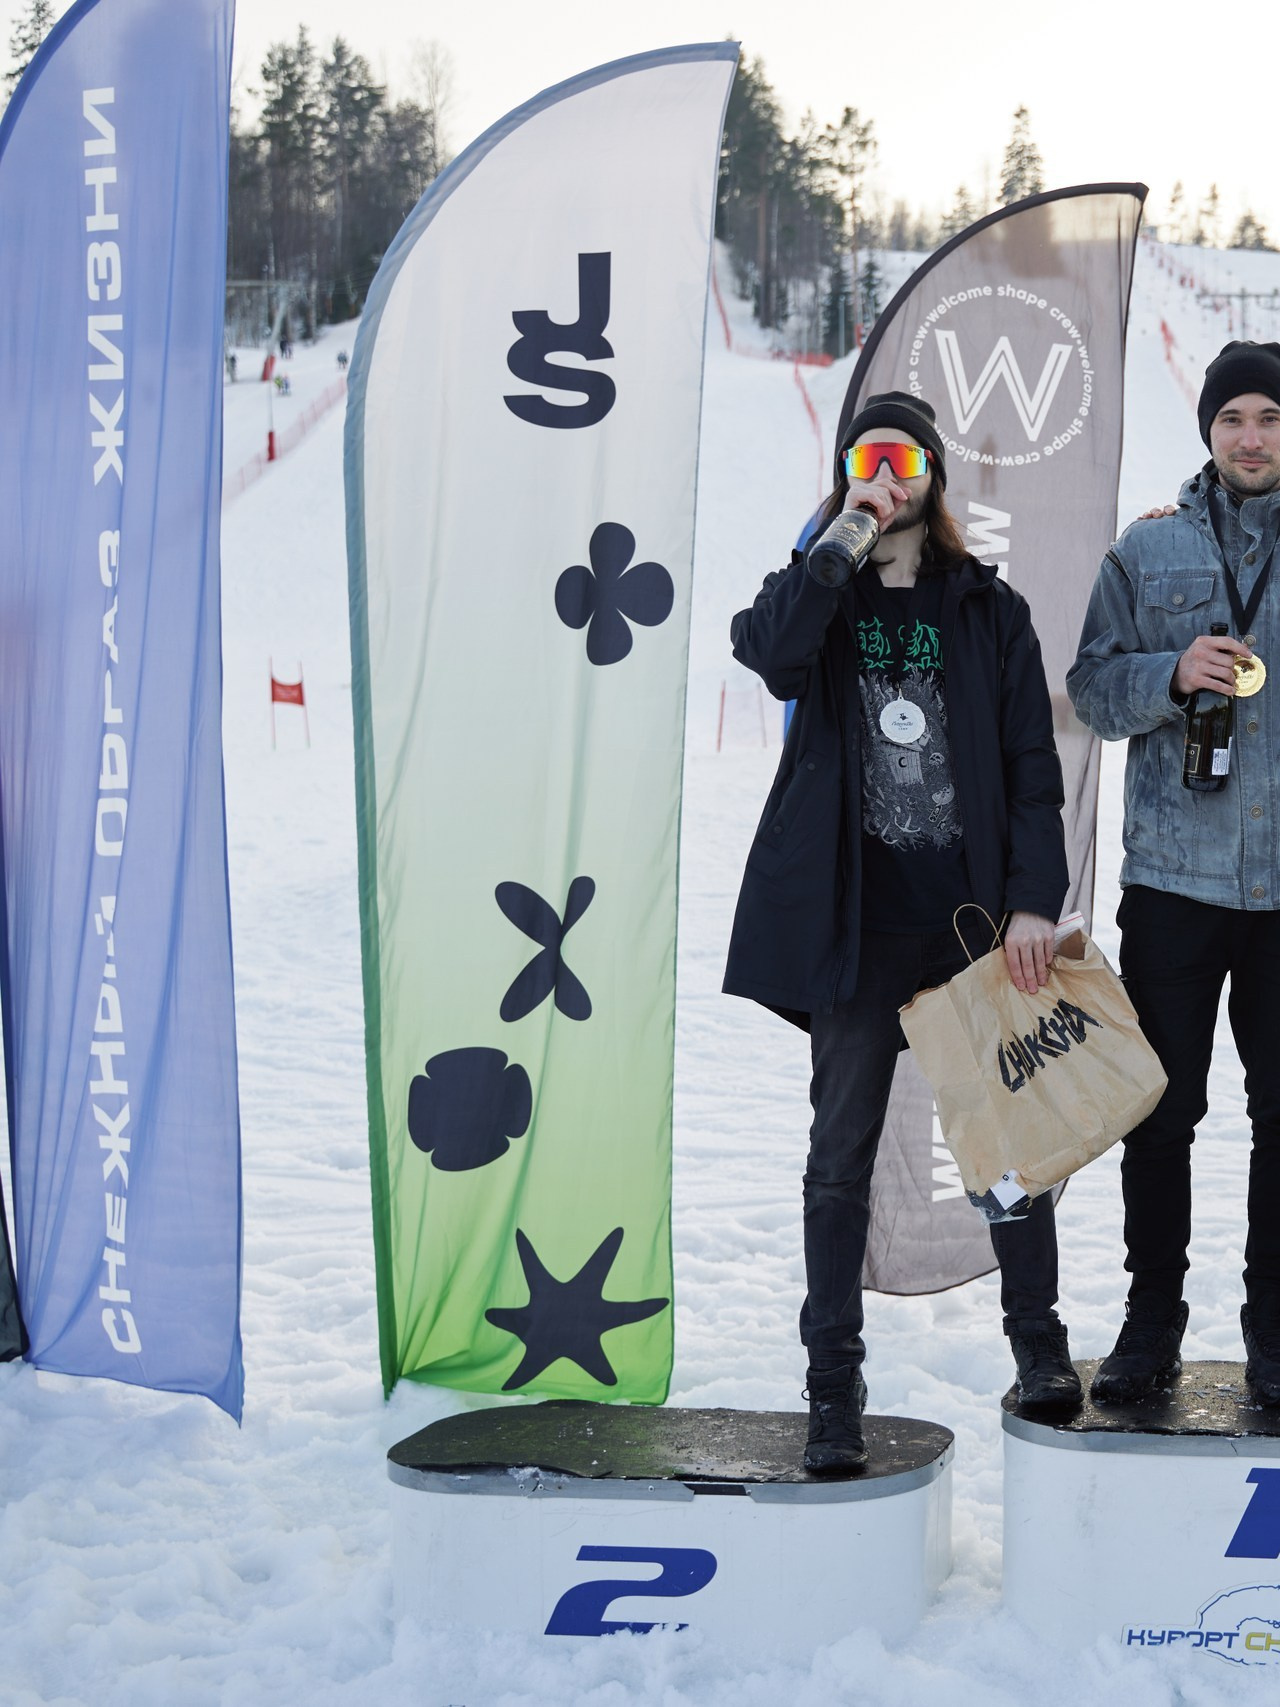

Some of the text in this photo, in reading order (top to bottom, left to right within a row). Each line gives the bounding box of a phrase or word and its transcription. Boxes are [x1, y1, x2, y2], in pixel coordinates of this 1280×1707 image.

[82, 87, 125, 486] ЖИЗНИ
[926, 285, 993, 323] welcome
[997, 284, 1048, 310] shape
[1050, 307, 1082, 340] crew
[909, 325, 929, 366] crew
[934, 328, 1074, 442] W
[1078, 345, 1095, 417] welcome
[934, 423, 994, 465] welcom
[1043, 418, 1084, 456] shape
[1000, 450, 1041, 467] crew
[544, 1545, 717, 1637] 2
[1126, 1629, 1240, 1650] КУРОРТ
